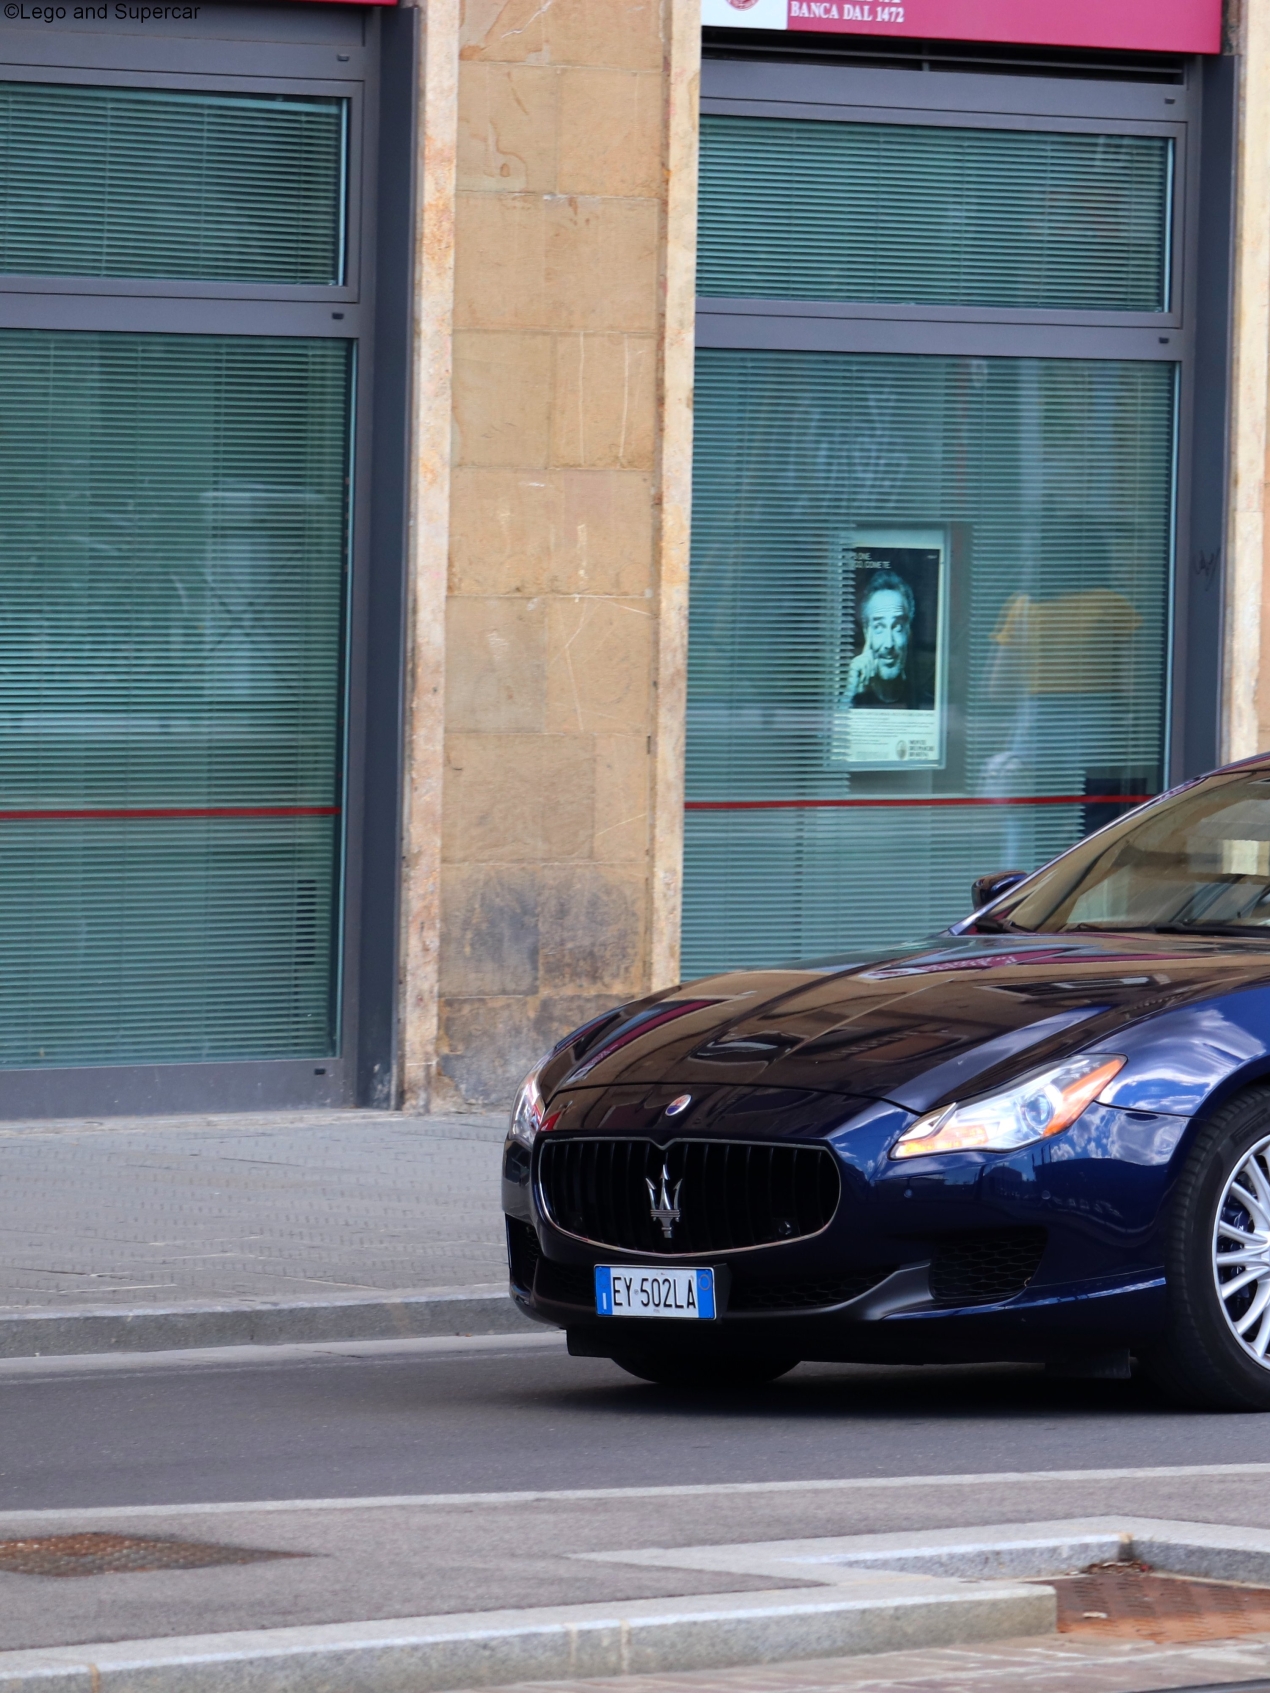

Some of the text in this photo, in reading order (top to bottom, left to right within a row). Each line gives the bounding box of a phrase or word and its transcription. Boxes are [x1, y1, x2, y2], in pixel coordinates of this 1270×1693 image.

[790, 1, 904, 22] BANCA DAL 1472
[612, 1276, 697, 1310] EY 502LA
